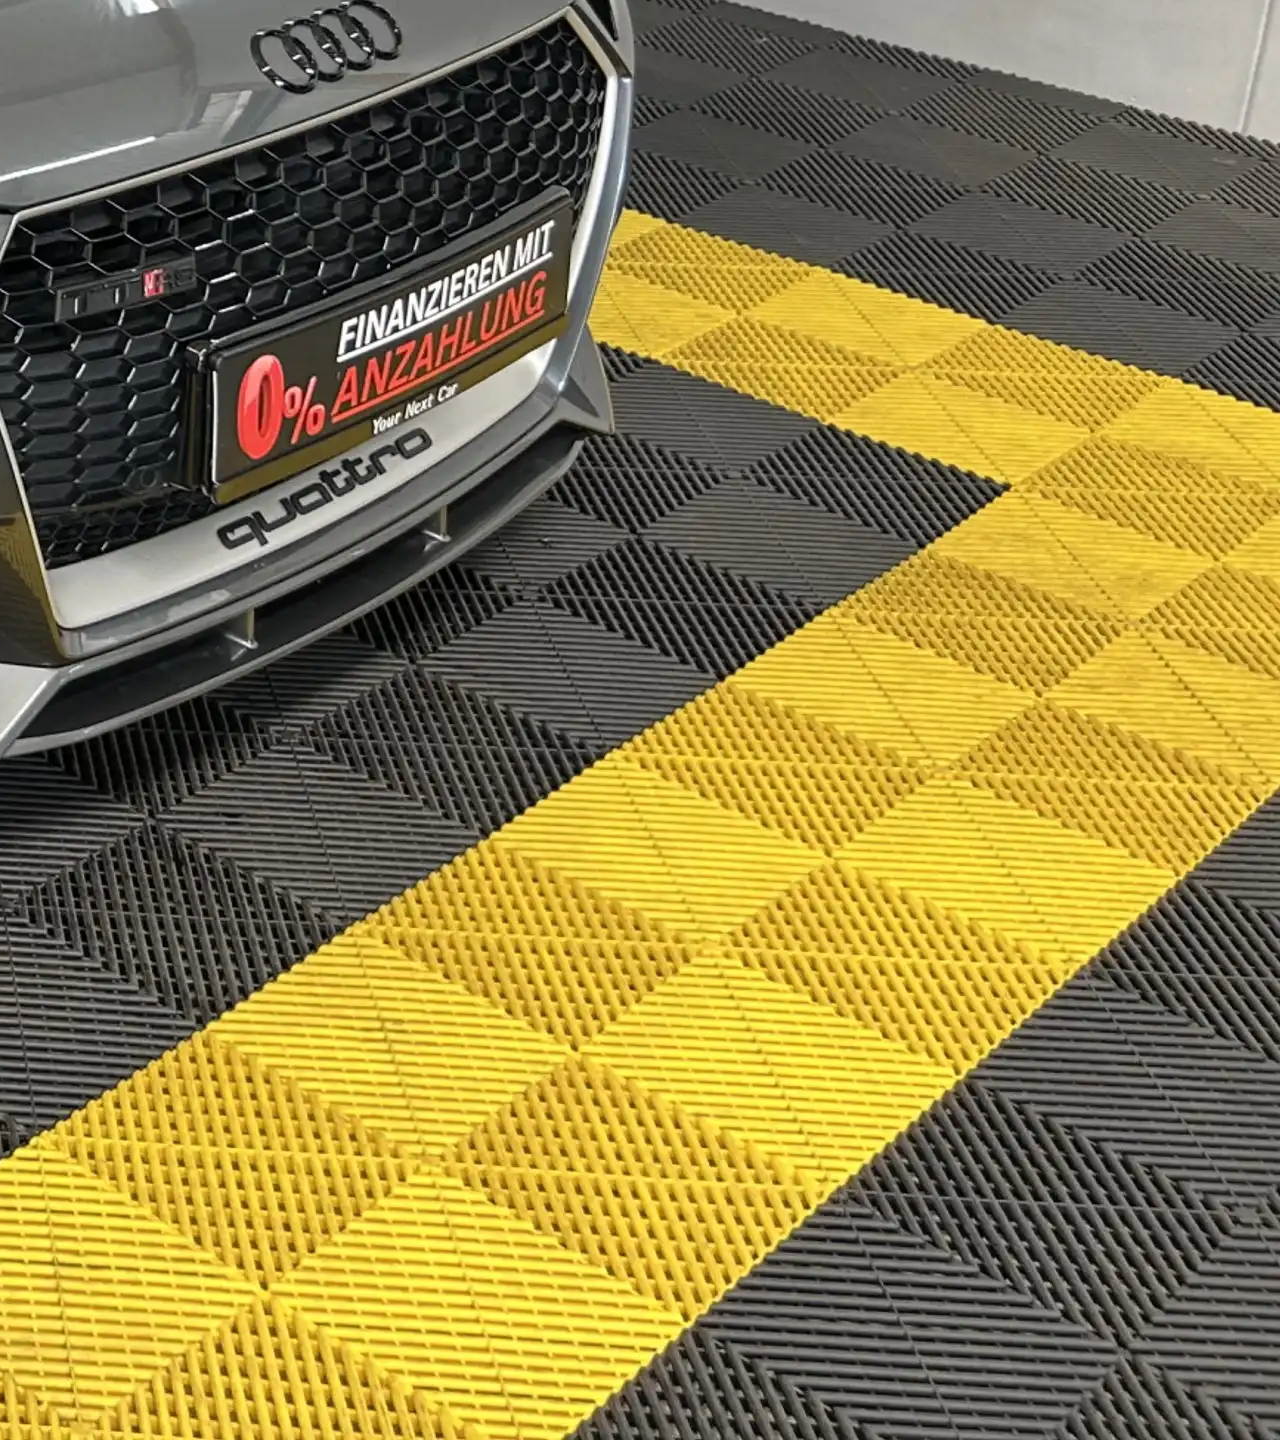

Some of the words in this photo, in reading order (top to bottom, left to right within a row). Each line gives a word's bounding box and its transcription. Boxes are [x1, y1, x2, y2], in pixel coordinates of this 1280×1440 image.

[337, 251, 511, 357] FINANZIEREN
[512, 219, 556, 270] MIT
[237, 354, 326, 459] 0%
[331, 270, 548, 417] ANZAHLUNG
[372, 411, 402, 435] Your
[404, 393, 434, 420] Next
[437, 381, 459, 402] Car
[216, 427, 433, 550] quattro
